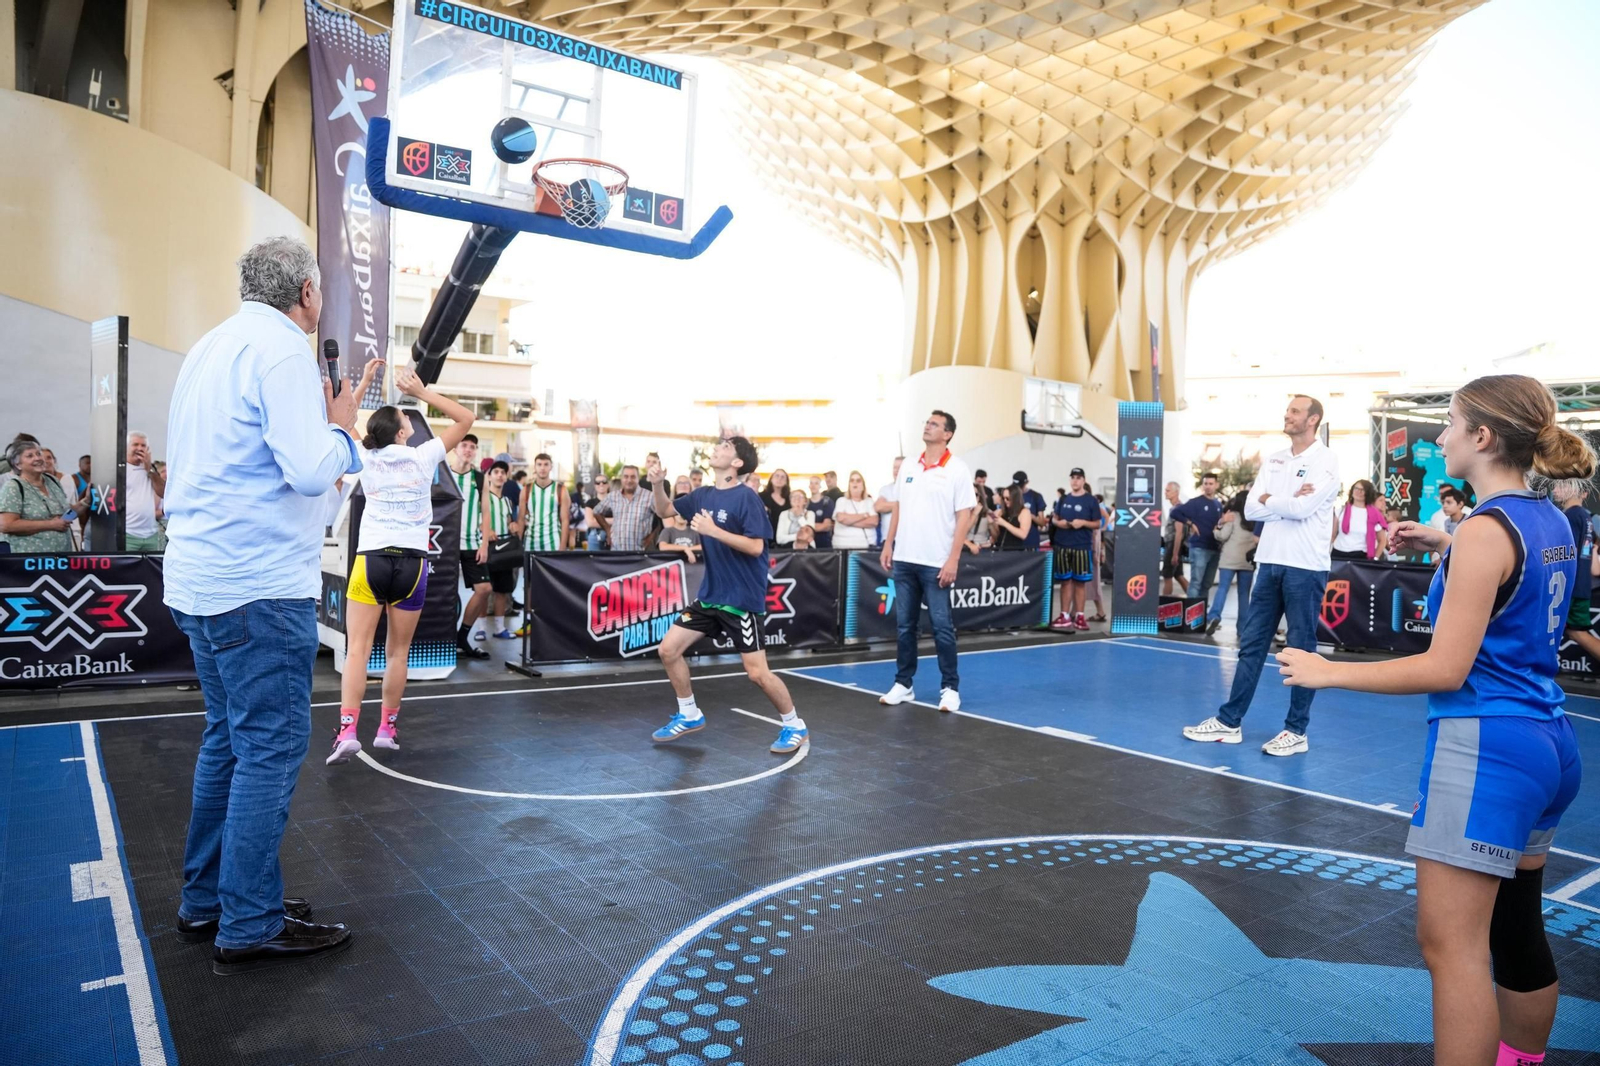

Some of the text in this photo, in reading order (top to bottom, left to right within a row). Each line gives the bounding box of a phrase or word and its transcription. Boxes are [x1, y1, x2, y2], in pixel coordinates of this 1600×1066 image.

[420, 0, 679, 88] #CIRCUITO3X3CAIXABANK
[438, 171, 468, 182] CaixaBank
[24, 557, 112, 571] CIRCUITO
[1541, 544, 1576, 566] ISABELA
[590, 563, 683, 636] CANCHA
[949, 575, 1031, 609] ixaBank
[623, 620, 650, 651] PARA
[712, 628, 787, 649] Caank
[1404, 621, 1434, 634] Caixa
[0, 652, 135, 680] CaixaBank
[1470, 842, 1515, 861] SEVILL
